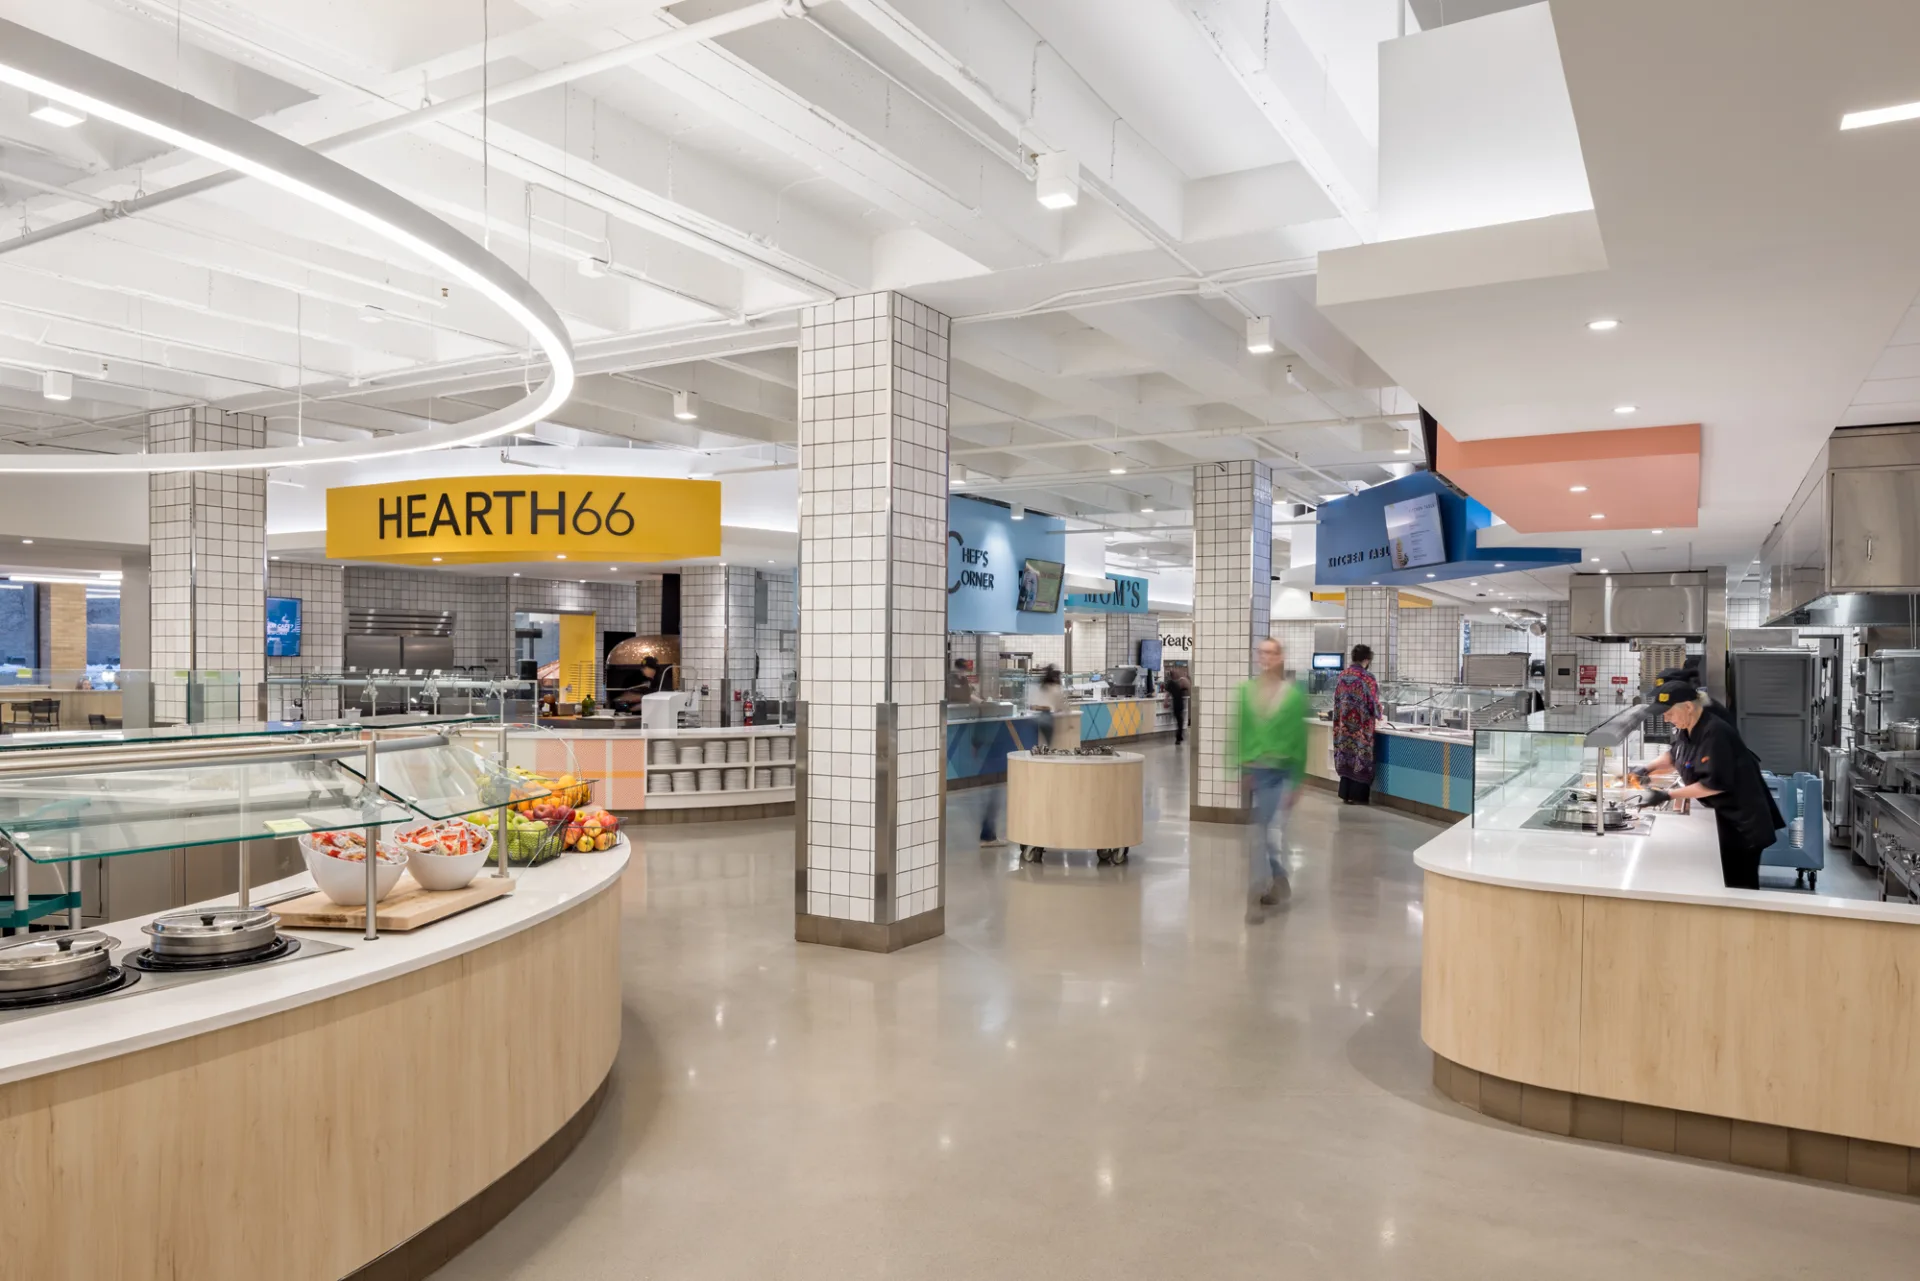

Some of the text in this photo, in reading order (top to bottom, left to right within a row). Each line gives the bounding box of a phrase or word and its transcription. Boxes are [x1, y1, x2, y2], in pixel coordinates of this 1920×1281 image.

[379, 490, 634, 539] HEARTH66
[1328, 546, 1391, 567] KITCHEN TABL
[1159, 634, 1192, 651] reats
